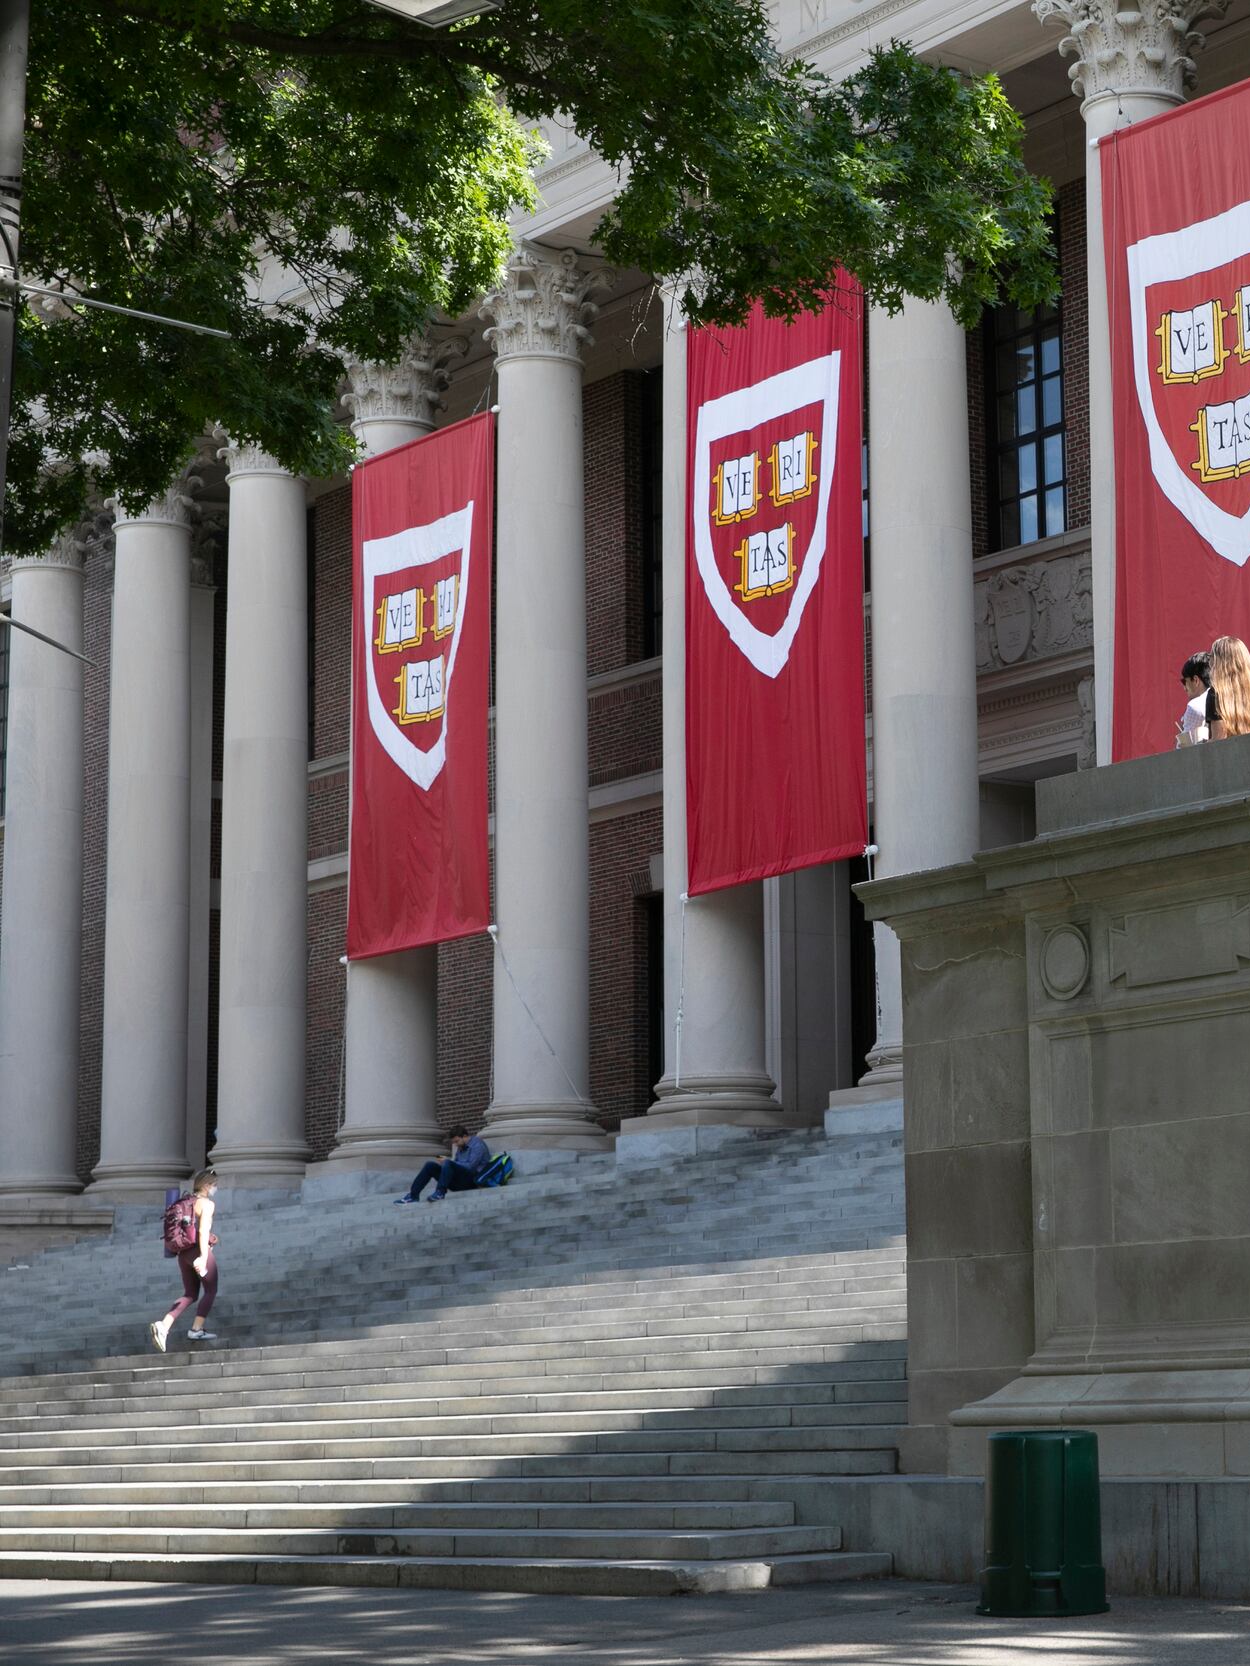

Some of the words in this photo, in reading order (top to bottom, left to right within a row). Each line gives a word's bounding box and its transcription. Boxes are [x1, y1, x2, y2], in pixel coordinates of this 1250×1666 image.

[1174, 322, 1208, 356] VE
[726, 471, 752, 499] VE
[782, 450, 802, 480] RI
[751, 541, 787, 572] TAS
[389, 604, 413, 630] VE
[412, 670, 441, 698] TAS
